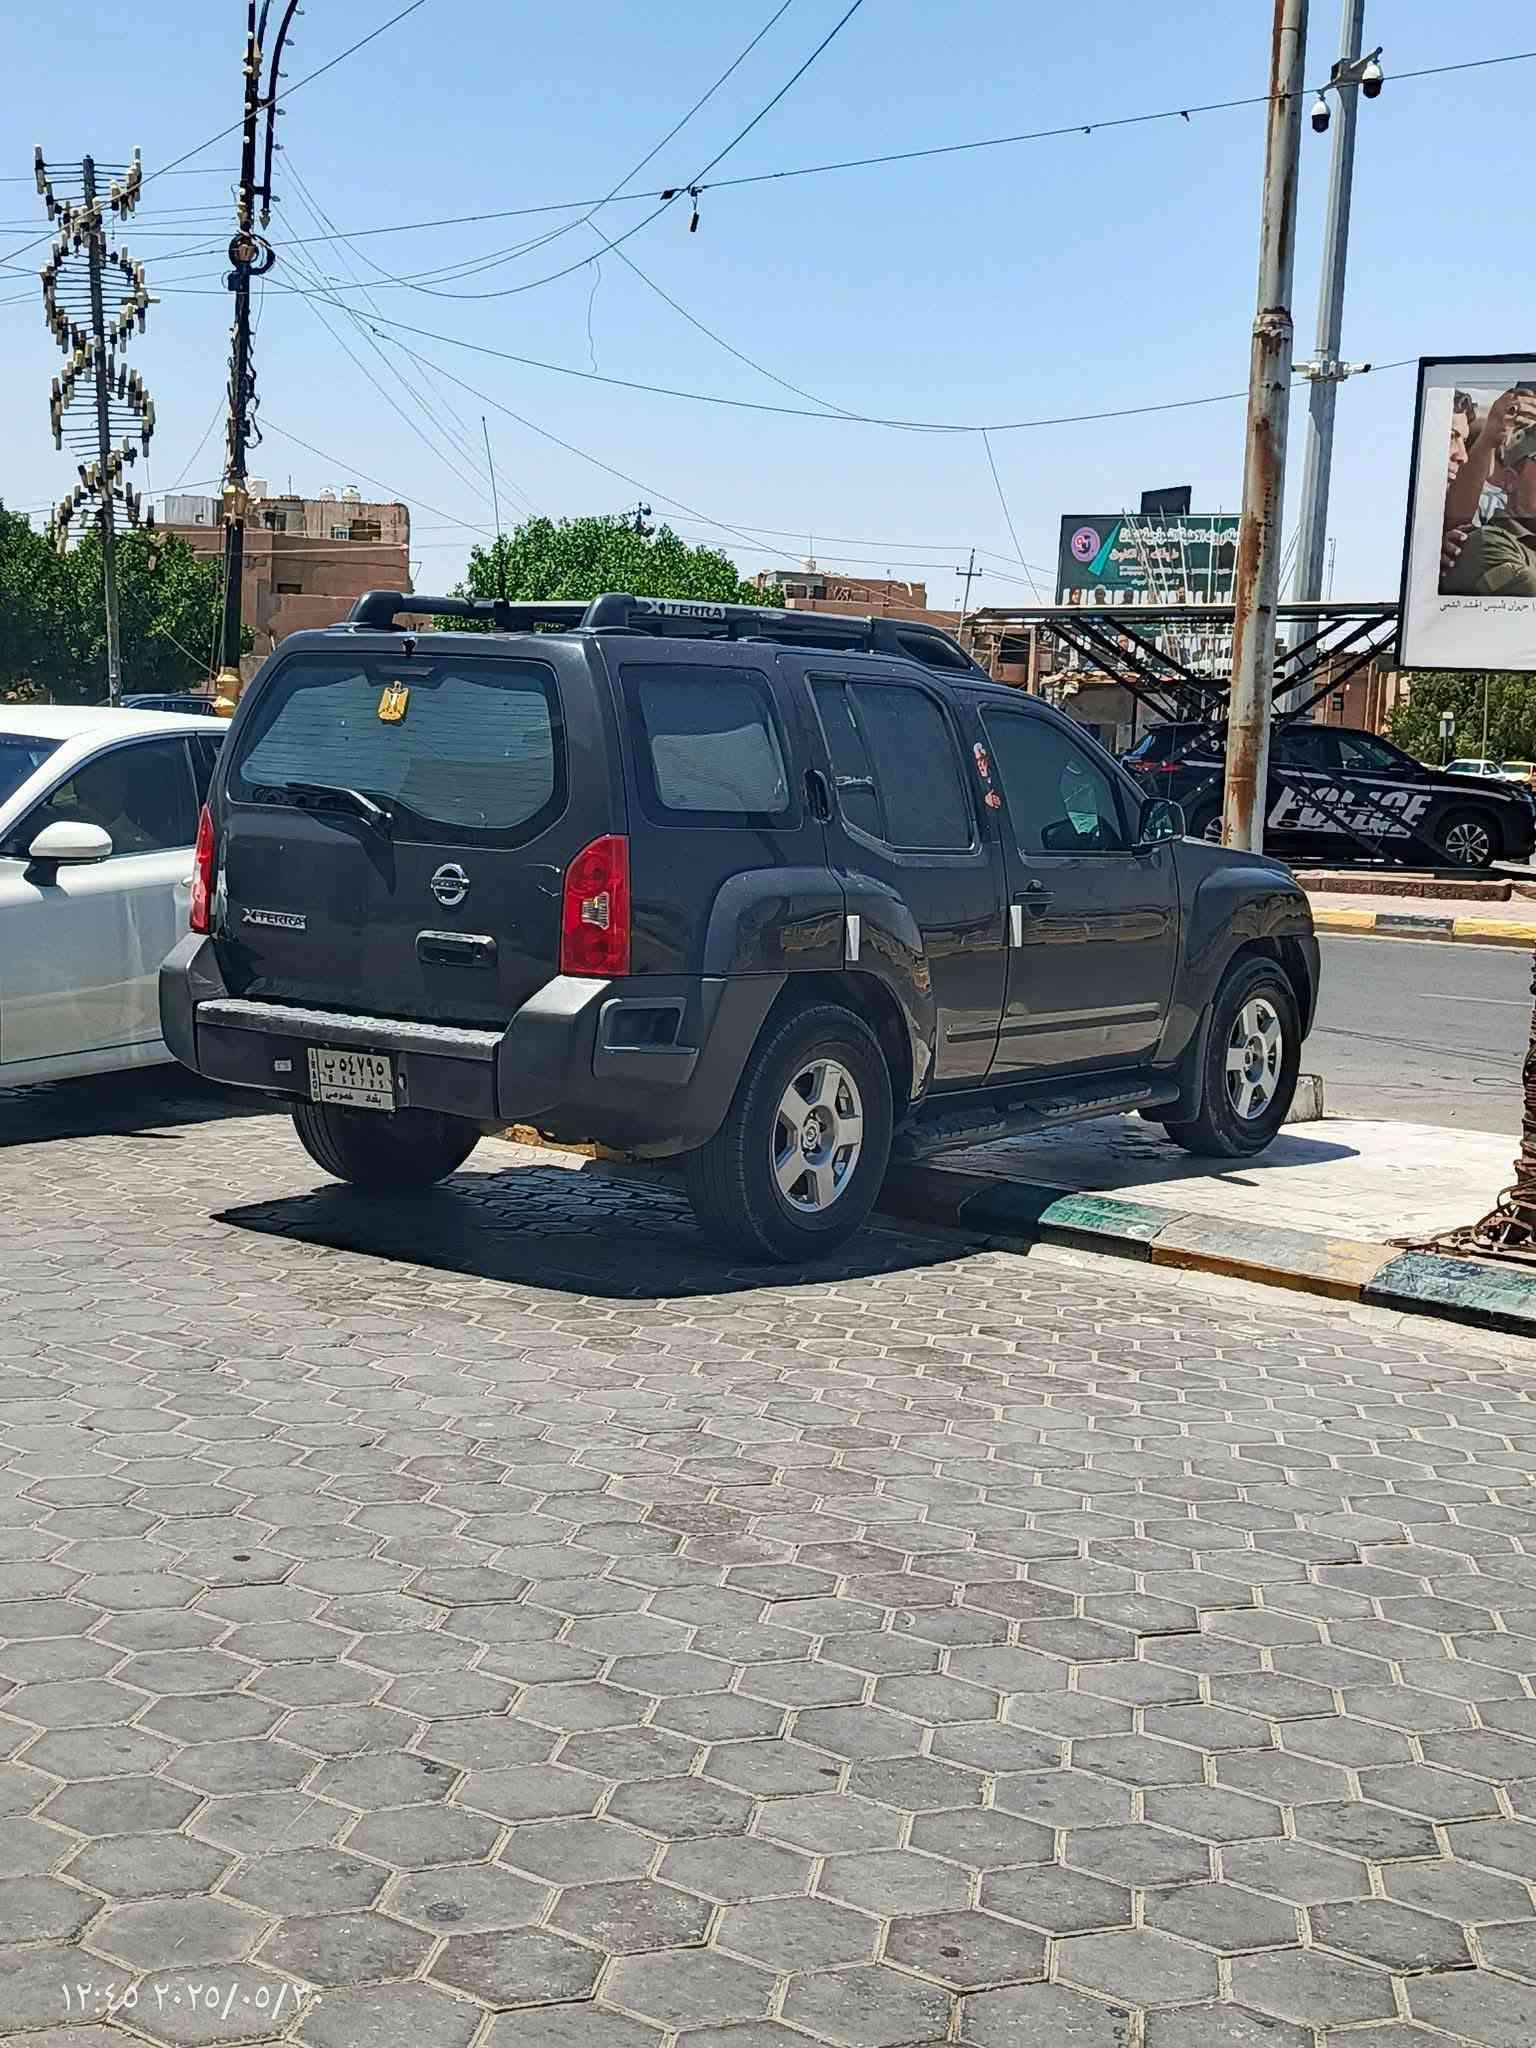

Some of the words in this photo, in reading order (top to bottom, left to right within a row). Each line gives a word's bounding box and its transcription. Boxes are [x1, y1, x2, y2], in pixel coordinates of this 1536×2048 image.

[1210, 739, 1227, 752] 91
[242, 908, 307, 930] XTERRA
[339, 1055, 385, 1079] ٥٤٧٩٥
